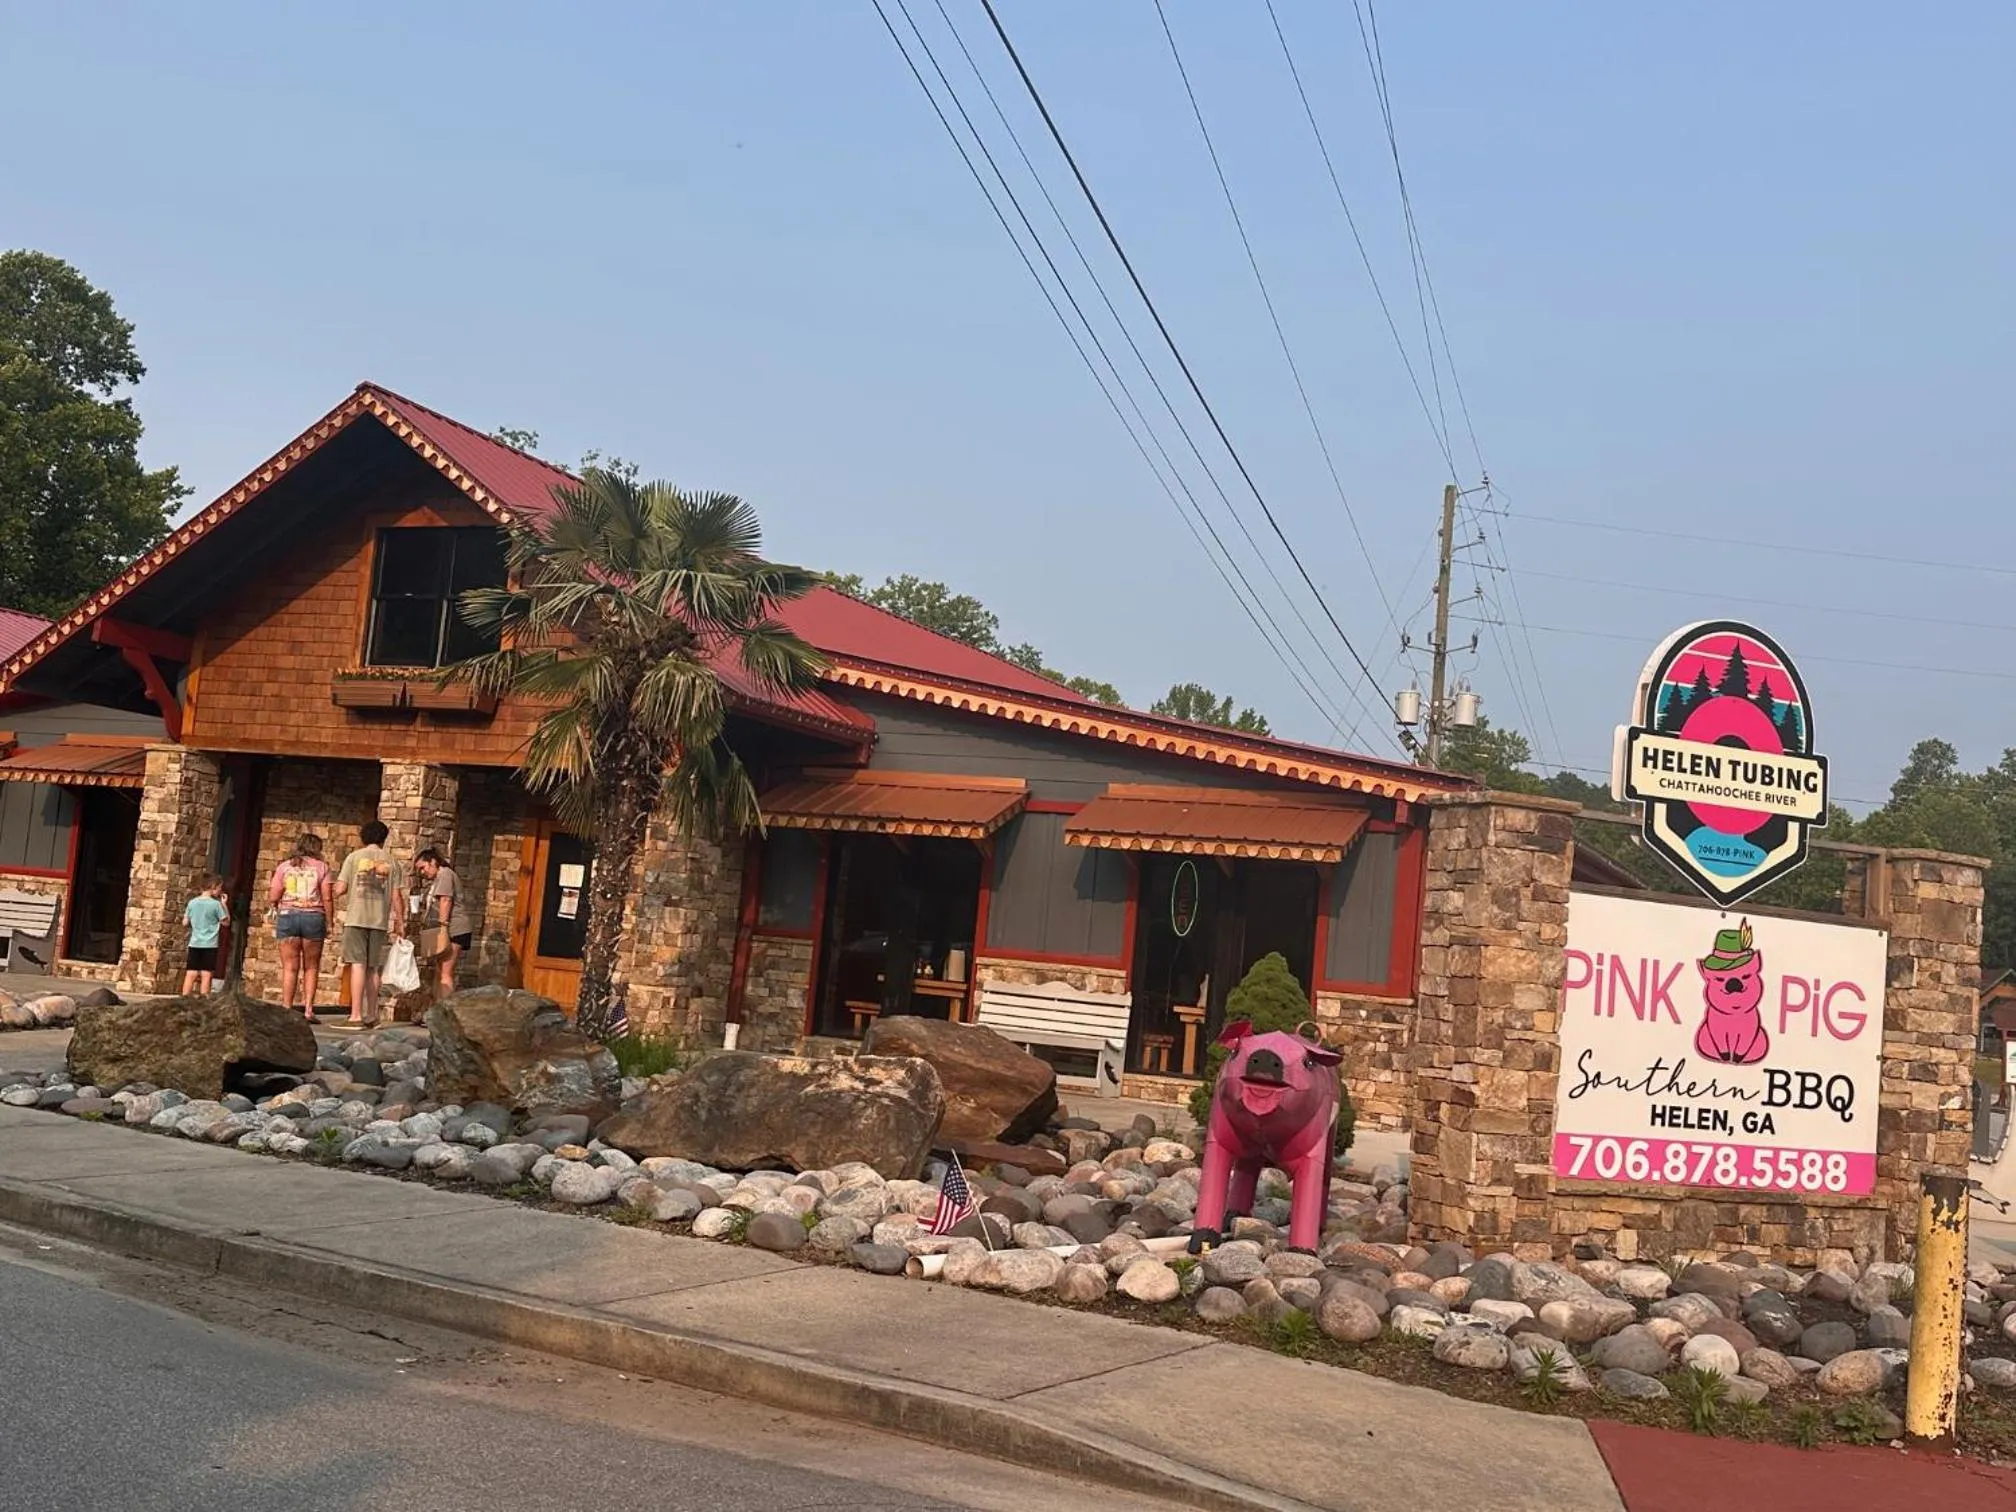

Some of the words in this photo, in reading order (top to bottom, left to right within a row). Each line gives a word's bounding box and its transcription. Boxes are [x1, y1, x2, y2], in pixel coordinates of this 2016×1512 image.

[1641, 746, 1721, 779] HELEN
[1728, 759, 1818, 794] TUBING
[1658, 777, 1761, 802] CHATTAHOOCHEE
[1764, 793, 1797, 807] RIVER
[1568, 1048, 1760, 1102] Southern
[1761, 1068, 1855, 1123] BBQ
[1650, 1104, 1734, 1136] HELEN,
[1741, 1111, 1776, 1135] GA
[1567, 1136, 1848, 1191] 706.878.5588
